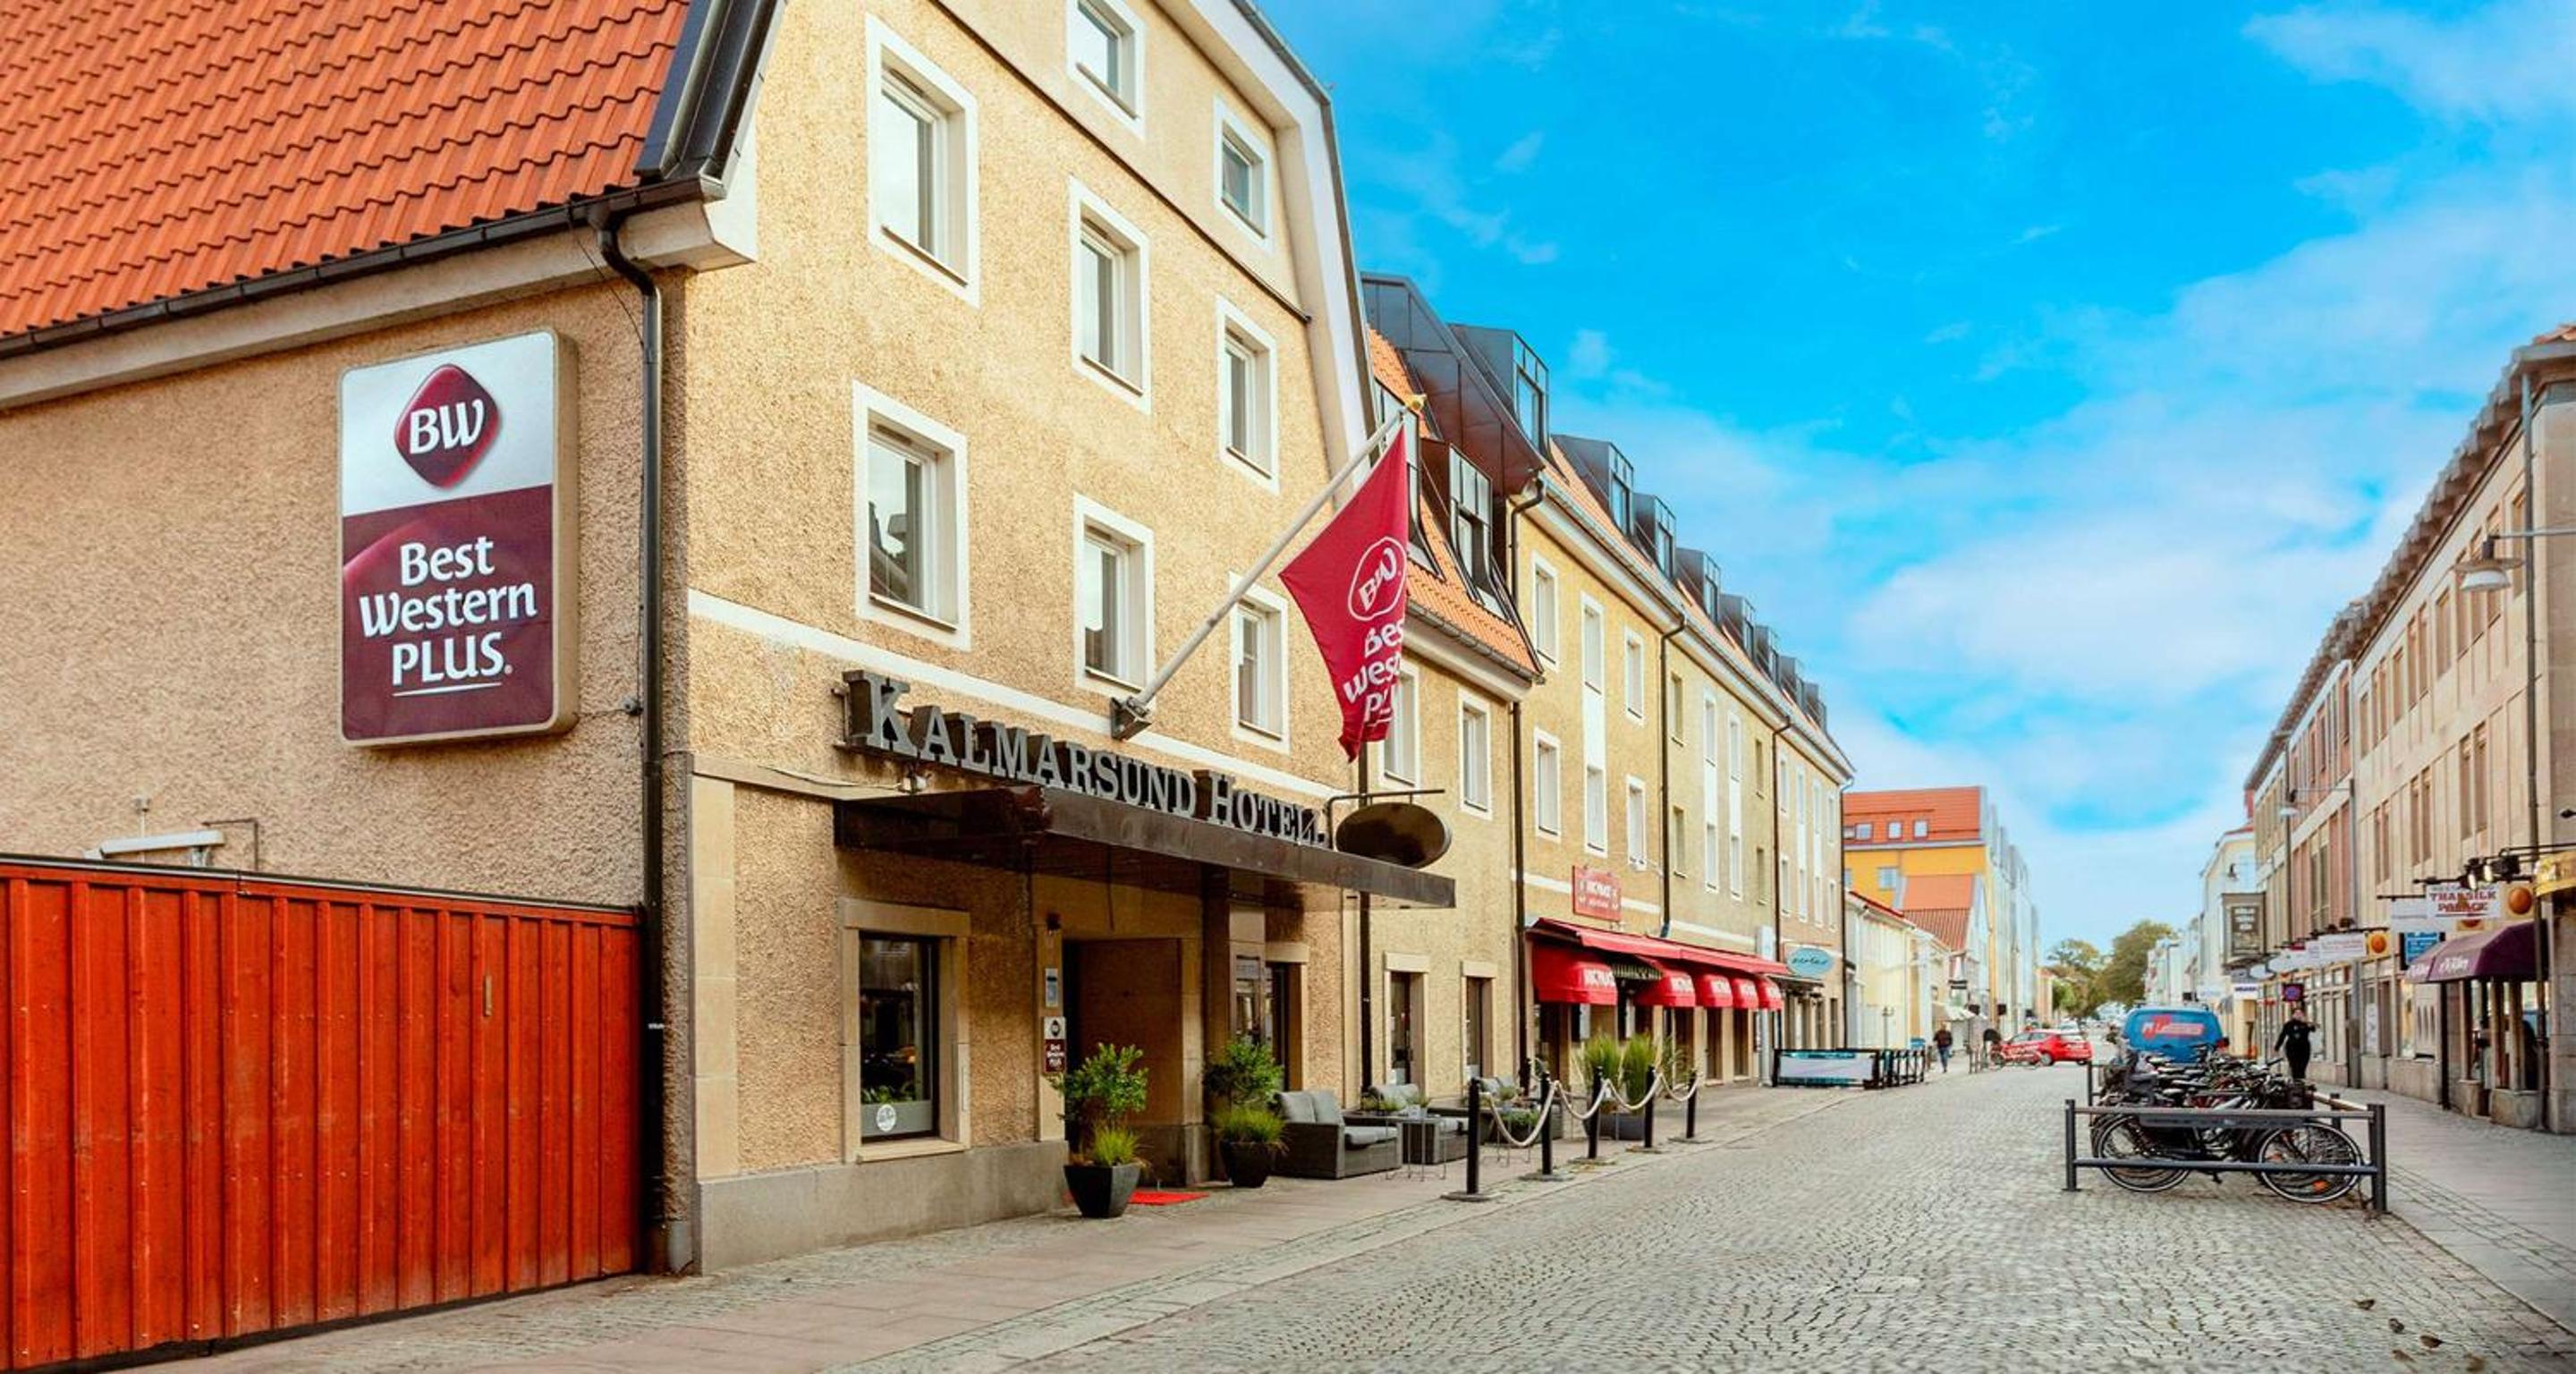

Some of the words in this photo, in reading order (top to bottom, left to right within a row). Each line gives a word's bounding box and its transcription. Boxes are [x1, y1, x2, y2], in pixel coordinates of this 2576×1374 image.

[409, 399, 486, 454] BW
[400, 536, 496, 586] Best
[1357, 547, 1397, 613] BW
[360, 581, 538, 638] Western
[845, 670, 1197, 818] KALMARSUND
